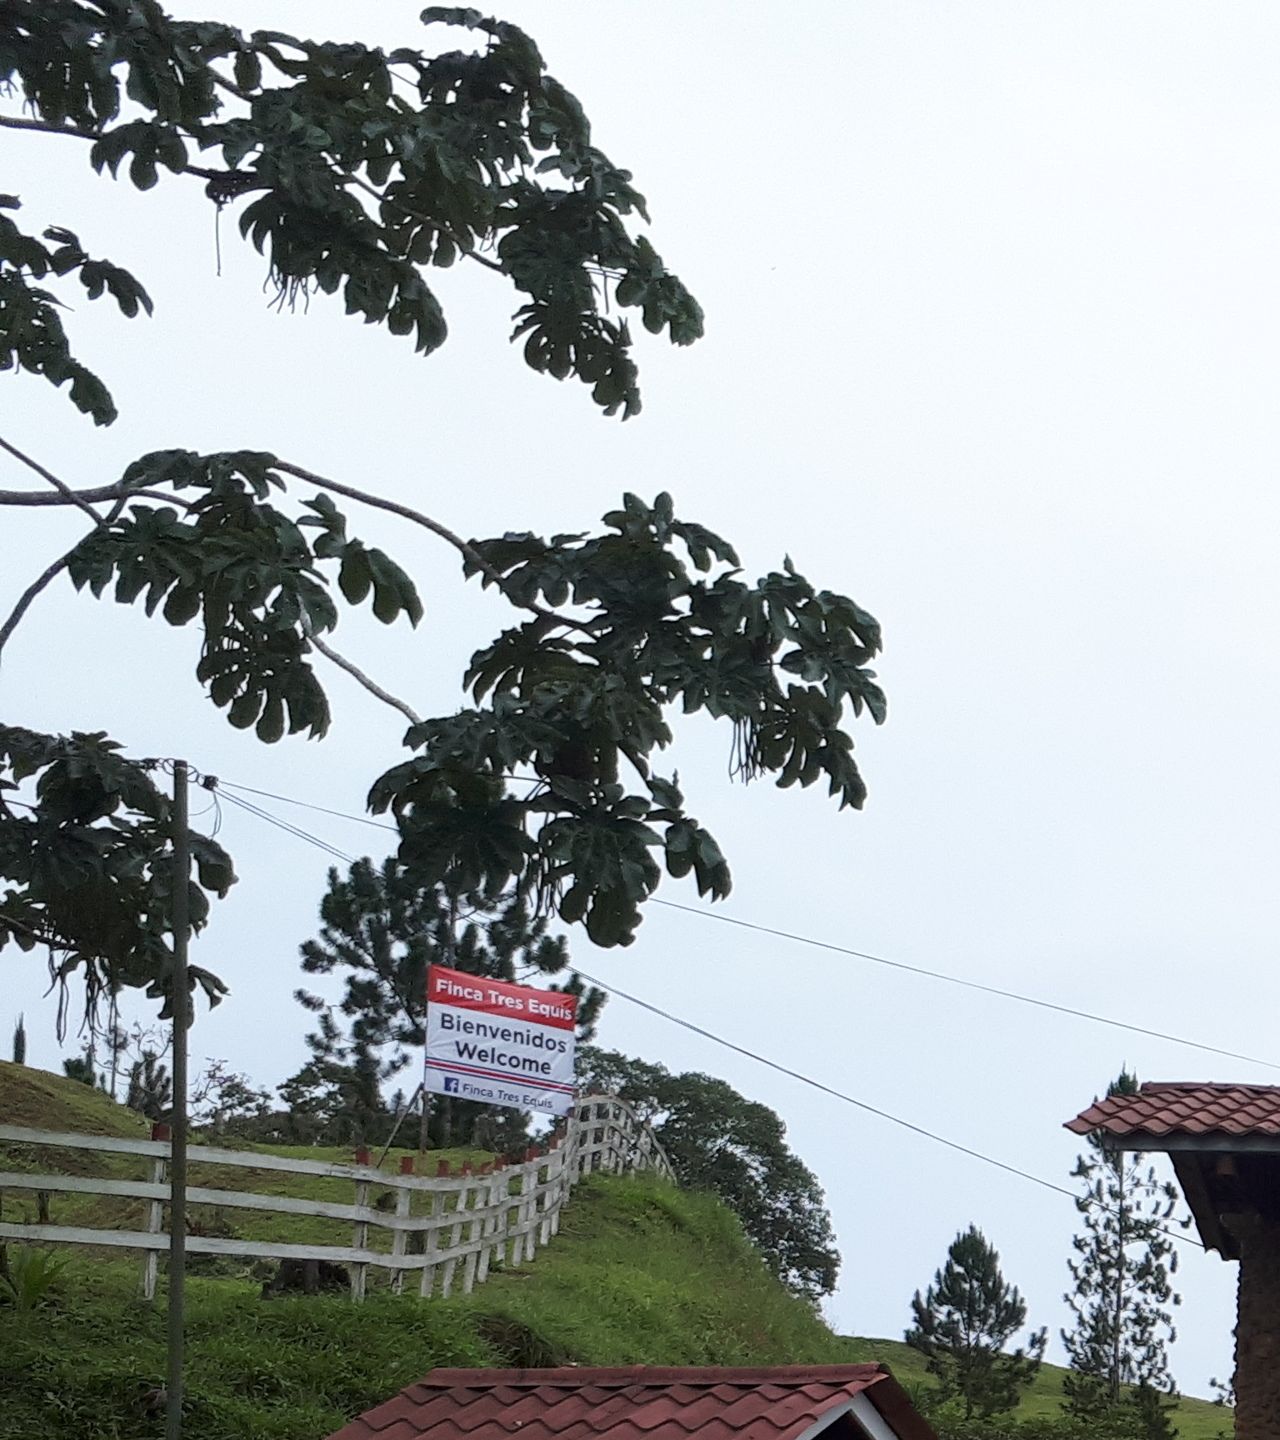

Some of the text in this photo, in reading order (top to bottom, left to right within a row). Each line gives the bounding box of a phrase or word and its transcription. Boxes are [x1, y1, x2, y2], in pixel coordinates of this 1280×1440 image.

[436, 978, 572, 1020] Finca Tres Equis
[440, 1013, 567, 1053] Bienvenidos
[455, 1041, 551, 1075] Welcome
[463, 1083, 493, 1098] Finca
[497, 1090, 520, 1103] Tres
[523, 1095, 553, 1109] Equis
